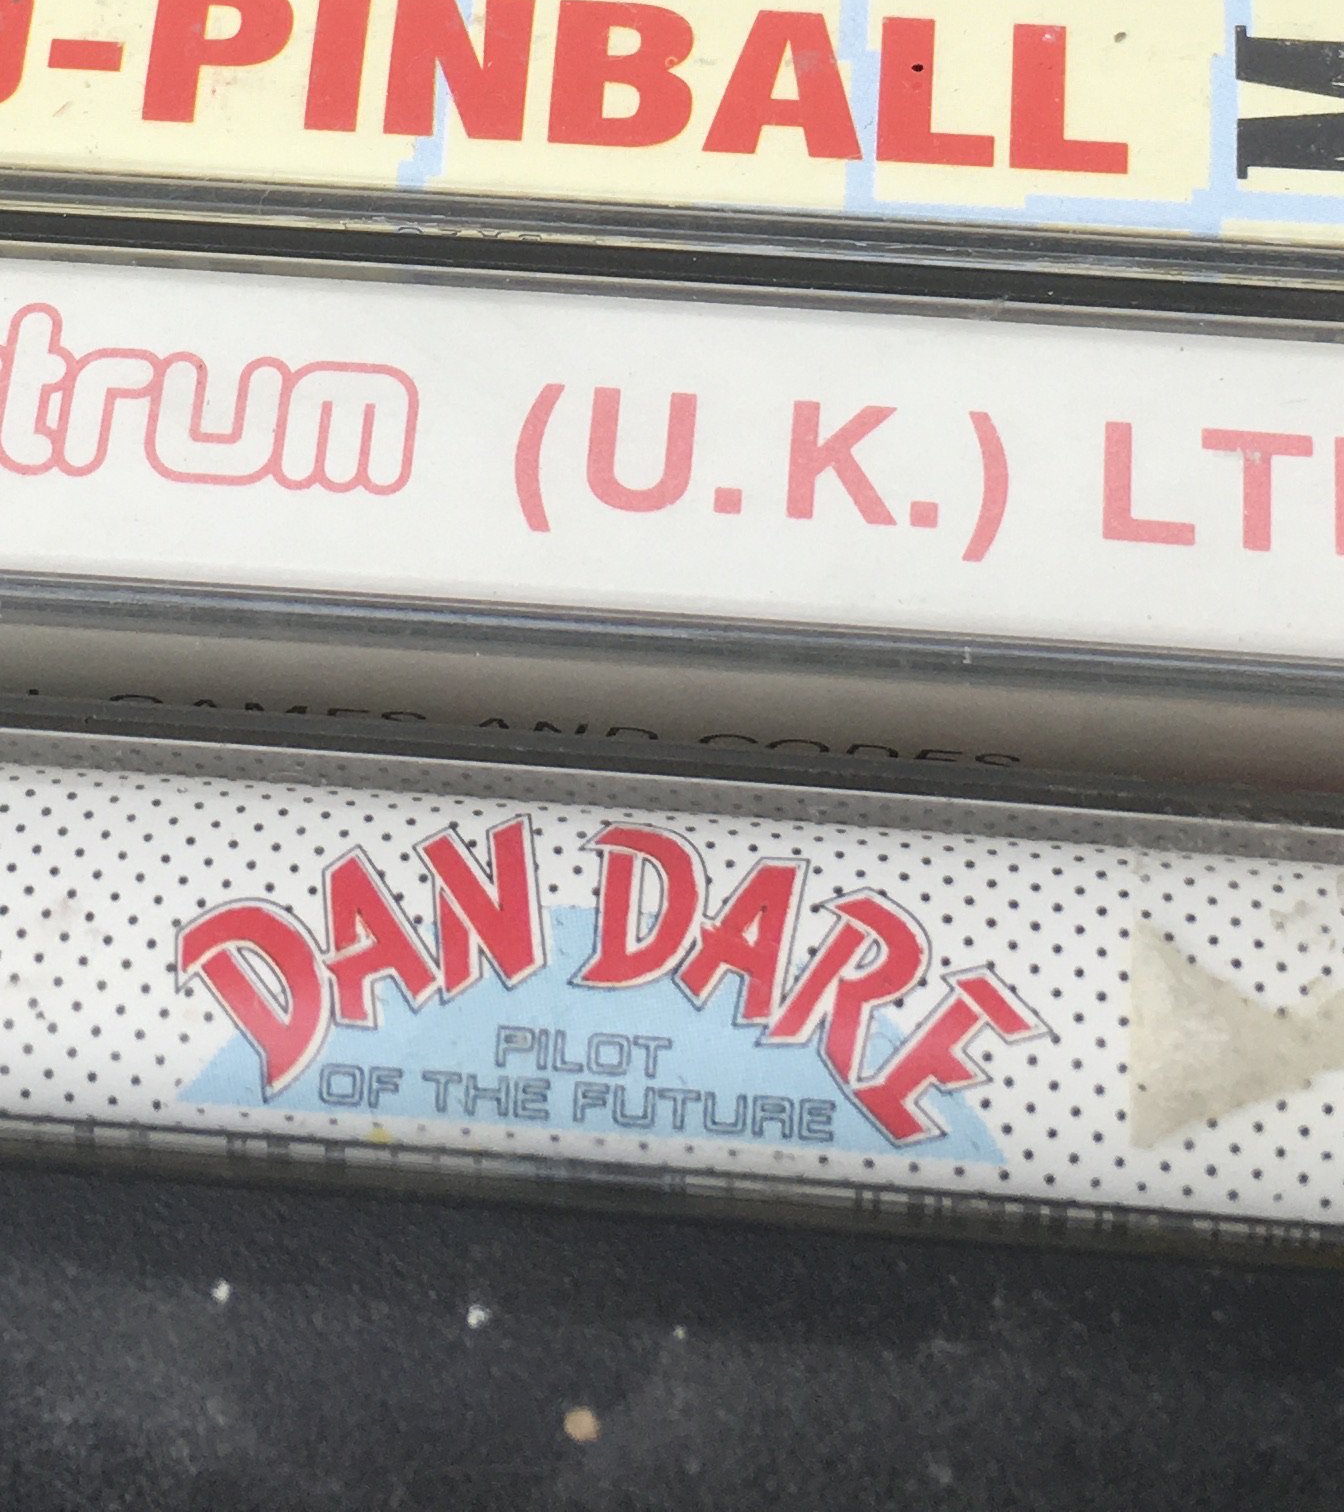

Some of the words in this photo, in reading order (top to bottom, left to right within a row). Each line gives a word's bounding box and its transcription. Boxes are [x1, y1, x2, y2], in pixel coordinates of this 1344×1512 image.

[513, 382, 1009, 562] (U.K.)
[175, 814, 546, 1102] DAN
[568, 821, 1055, 1148] DARE
[317, 1063, 405, 1107] OF
[421, 1068, 552, 1121] THE
[572, 1081, 835, 1144] FUTURE
[493, 1024, 673, 1080] PILOT
